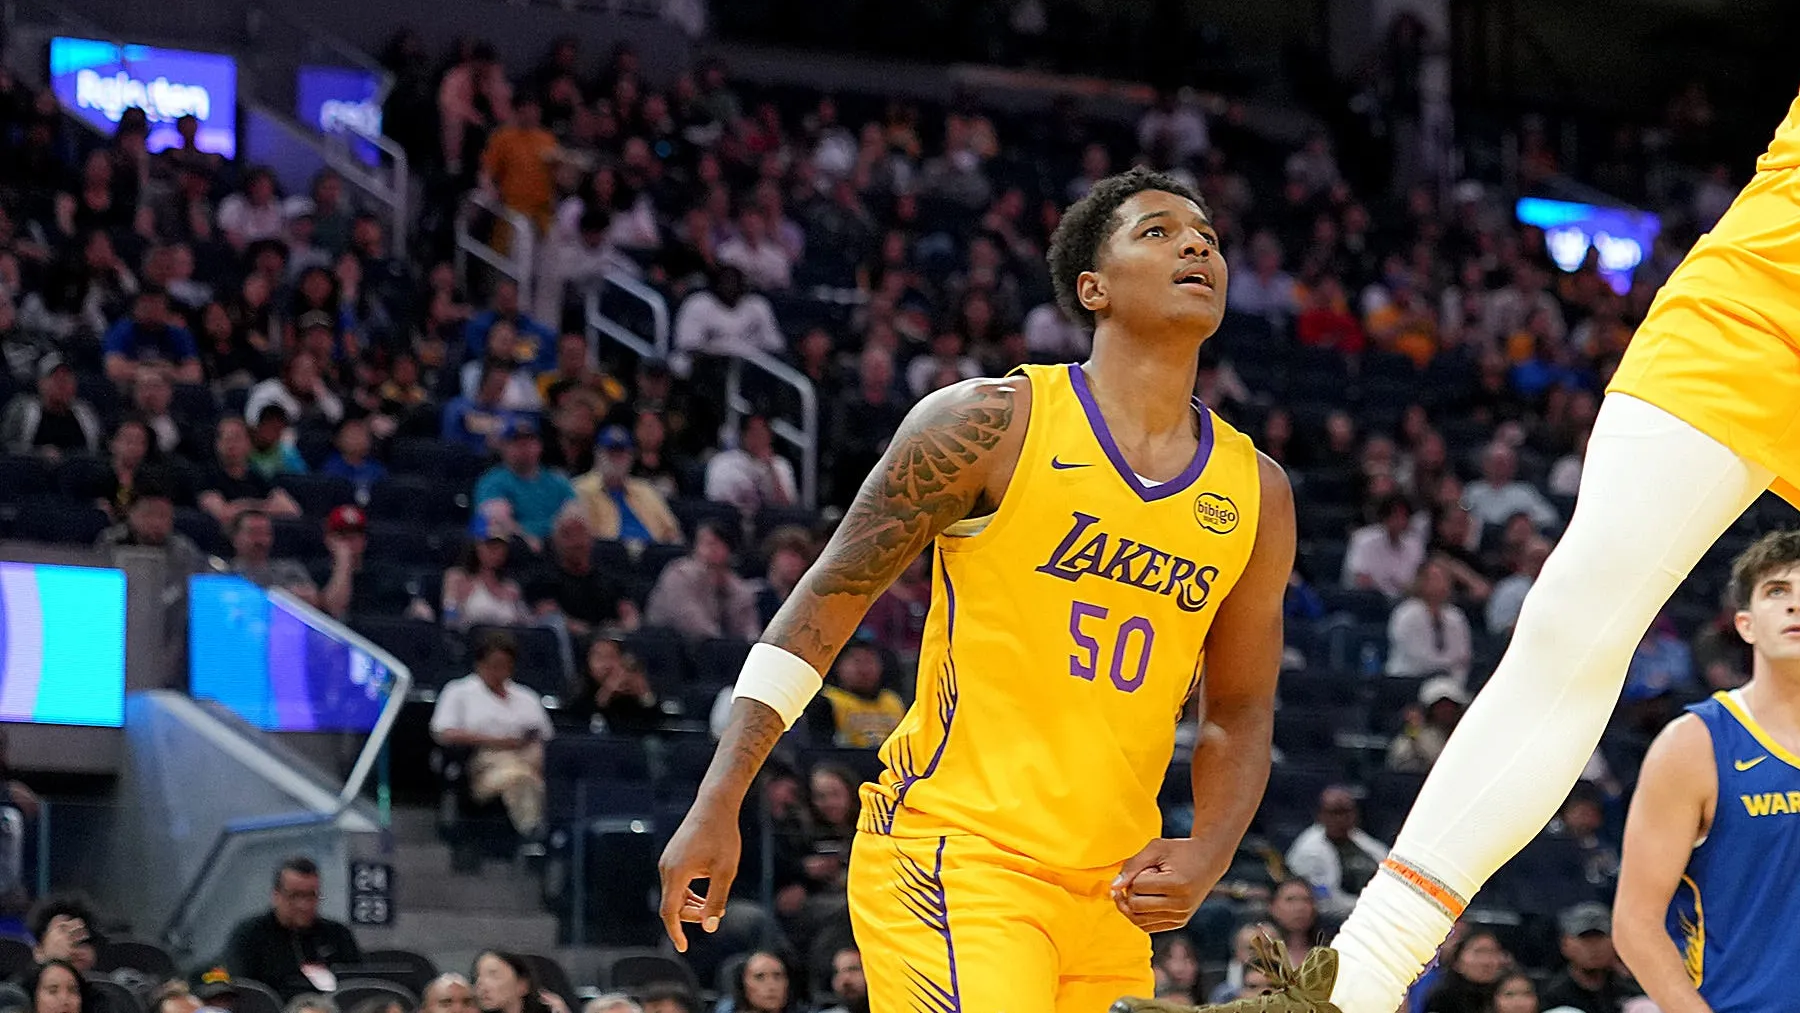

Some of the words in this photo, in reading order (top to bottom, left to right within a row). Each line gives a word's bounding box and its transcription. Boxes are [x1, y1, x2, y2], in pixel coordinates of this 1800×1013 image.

[1198, 500, 1236, 524] bibigo
[1034, 510, 1220, 613] LAKERS
[1069, 600, 1155, 693] 50
